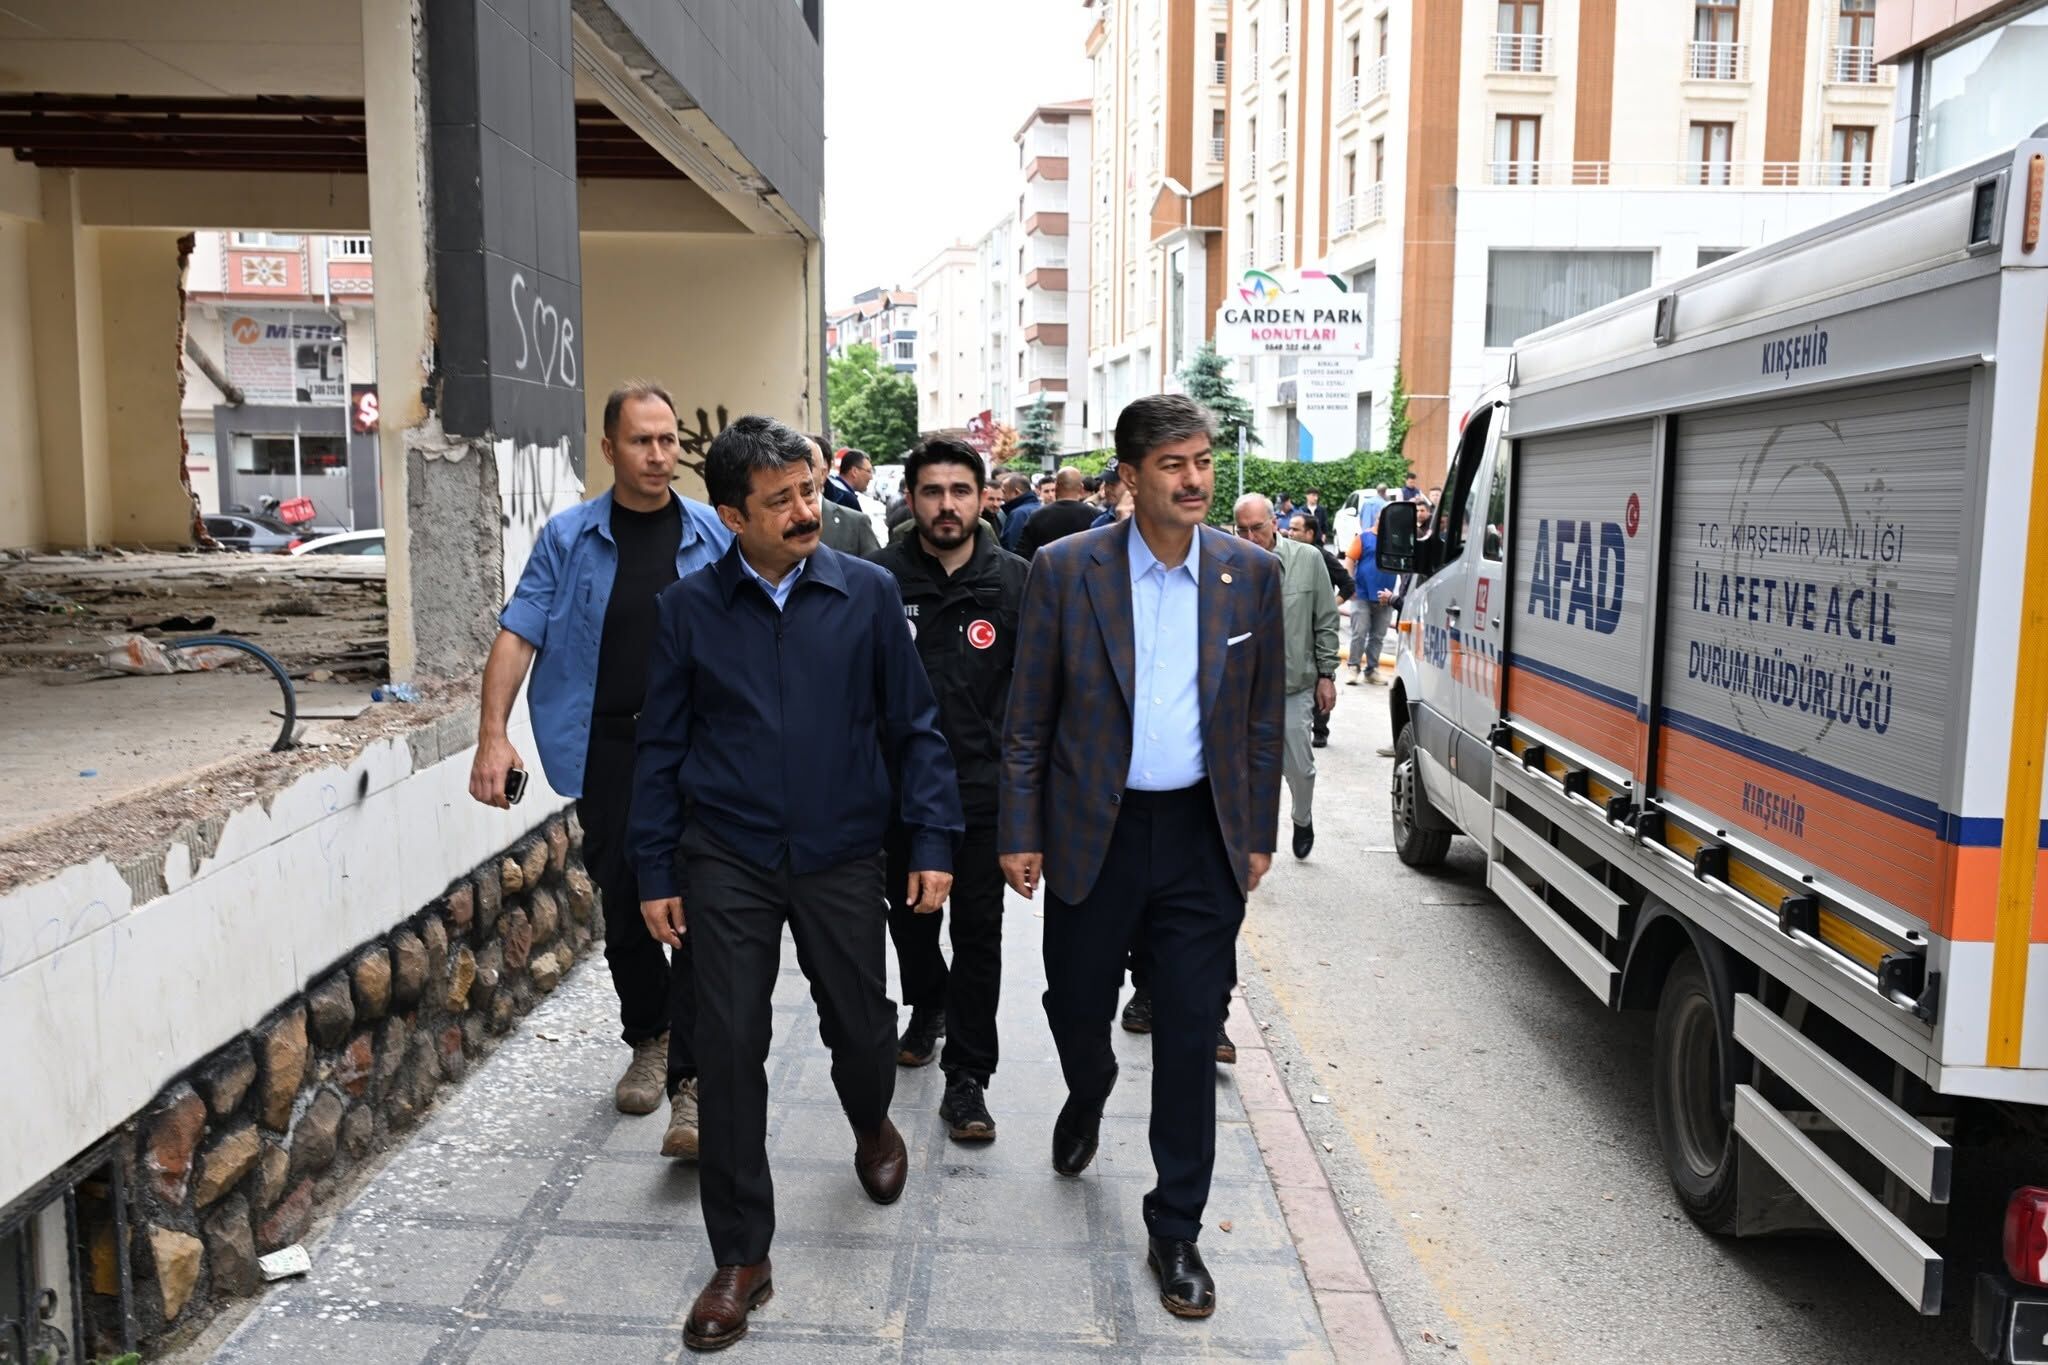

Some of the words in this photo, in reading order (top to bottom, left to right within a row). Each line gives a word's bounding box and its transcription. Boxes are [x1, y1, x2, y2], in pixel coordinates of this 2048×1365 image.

[1224, 309, 1305, 324] GARDEN
[1313, 309, 1363, 324] PARK
[1250, 328, 1337, 341] KONUTLARI
[1761, 324, 1828, 380] KIRŞEHİR
[1731, 521, 1811, 559] KIRŞEHİR
[1817, 523, 1905, 563] VALİLİĞİ
[1527, 519, 1626, 635] AFAD
[1693, 560, 1711, 613] İL
[1717, 574, 1777, 624] AFET
[1783, 580, 1816, 631] VE
[1824, 577, 1896, 646] ACİL
[1423, 623, 1448, 670] AFAD
[1688, 640, 1750, 695] DURUM
[1752, 647, 1893, 735] MÜDÜRLÜĞÜ
[1741, 780, 1806, 839] KIRŞEHİR
